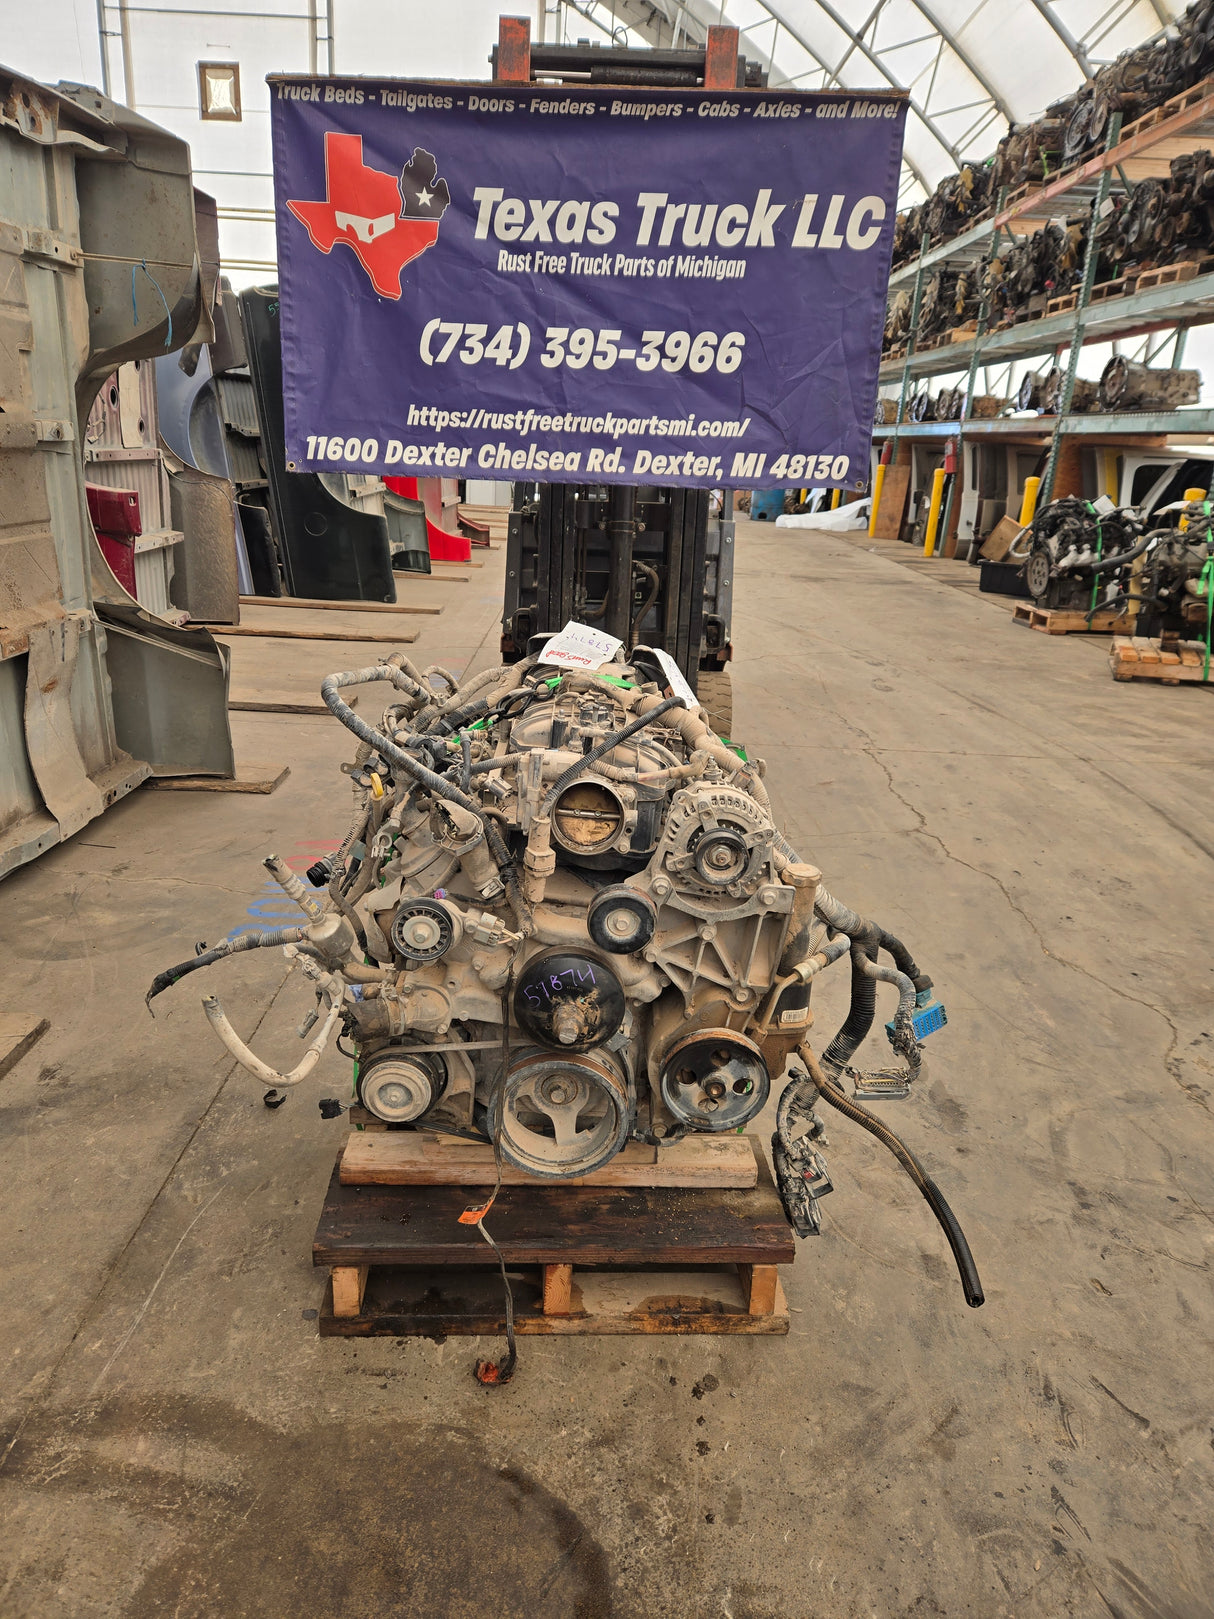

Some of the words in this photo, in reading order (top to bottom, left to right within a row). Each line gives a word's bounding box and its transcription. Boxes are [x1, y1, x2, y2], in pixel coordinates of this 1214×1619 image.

[277, 83, 320, 101] Truck
[324, 86, 364, 104] Beds
[381, 90, 452, 112] Tailgates
[468, 96, 514, 112] Doors
[530, 99, 595, 114] Fenders
[611, 101, 683, 120] Bumpers
[698, 101, 740, 116] Cabs
[753, 102, 801, 117] Axles
[816, 102, 848, 118] and
[851, 102, 899, 118] More!
[473, 187, 619, 244] Texas
[636, 189, 786, 247] Truck
[792, 194, 885, 250] LLC
[498, 250, 531, 272] Rust
[534, 251, 566, 273] Free
[571, 253, 612, 275] Truck
[614, 254, 655, 276] Parts
[657, 256, 674, 277] of
[675, 256, 746, 280] Michigan
[420, 318, 530, 369] (734)
[541, 327, 745, 373] 395-3966
[407, 405, 750, 439] https://rustfreetruckpartsmi.com/
[307, 436, 378, 462] 11600
[384, 440, 472, 467] Dexter
[478, 443, 581, 471] Chelsea
[586, 447, 625, 473] Rd.
[633, 450, 723, 480] Dexter,
[730, 453, 766, 477] MI
[769, 455, 849, 480] 48130
